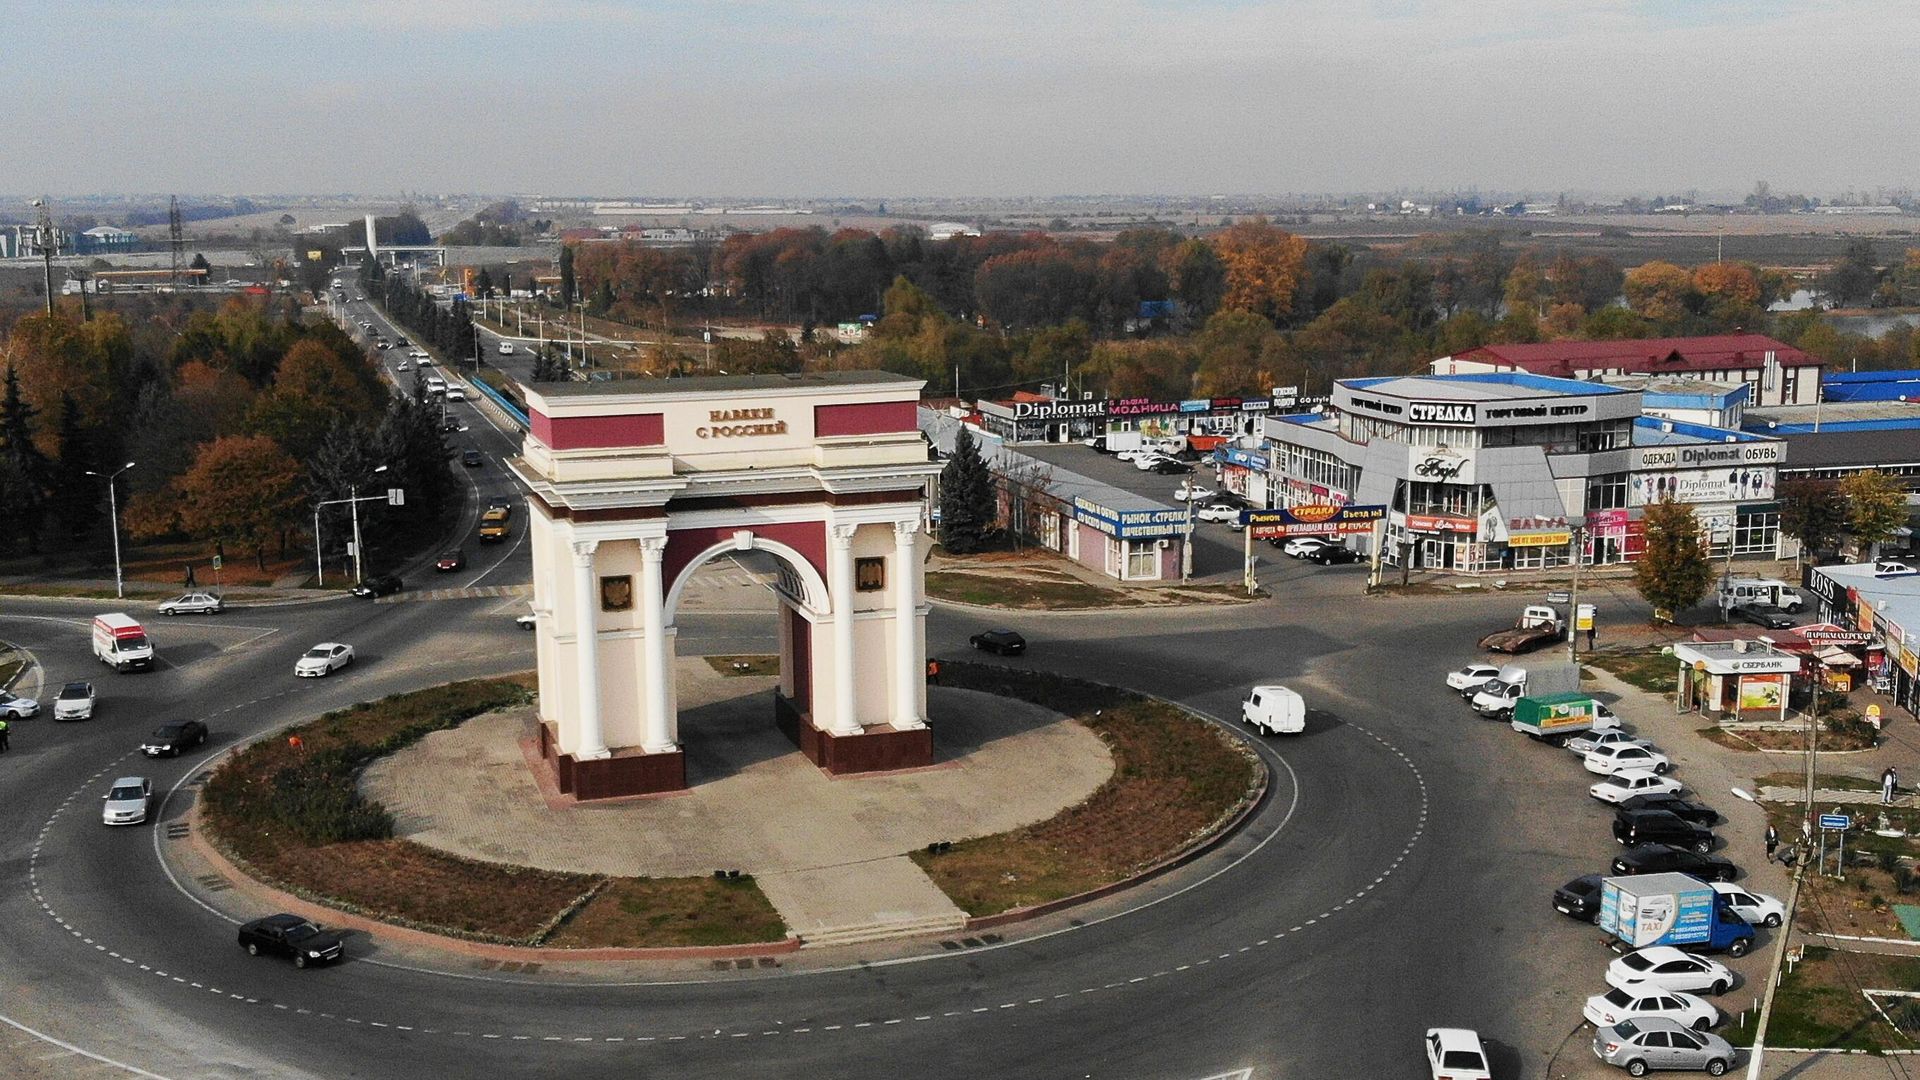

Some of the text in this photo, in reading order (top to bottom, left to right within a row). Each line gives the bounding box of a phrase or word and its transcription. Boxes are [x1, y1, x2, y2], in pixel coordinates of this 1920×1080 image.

[1015, 401, 1105, 419] Diplomat
[1109, 403, 1178, 414] МОДНИЦА
[1409, 404, 1474, 421] СТРЕЛКА
[1485, 404, 1547, 418] ТОРГОВЫЙ
[696, 427, 707, 438] С
[1642, 452, 1676, 465] ОДЕЖДА
[1682, 448, 1741, 465] Diplomat
[1745, 448, 1777, 460] ОБУВЬ
[1679, 479, 1726, 491] Diplomat
[1121, 513, 1151, 524] РЫНОК
[1250, 514, 1281, 522] Рынок
[1294, 507, 1334, 515] СТРЕЛКА
[1343, 509, 1369, 519] Въезд
[1810, 569, 1835, 600] BOSS
[1806, 631, 1872, 640] ПАРИКМАХЕРСКАЯ
[1741, 661, 1783, 669] СБЕРБАНК
[1641, 922, 1663, 932] TAXI
